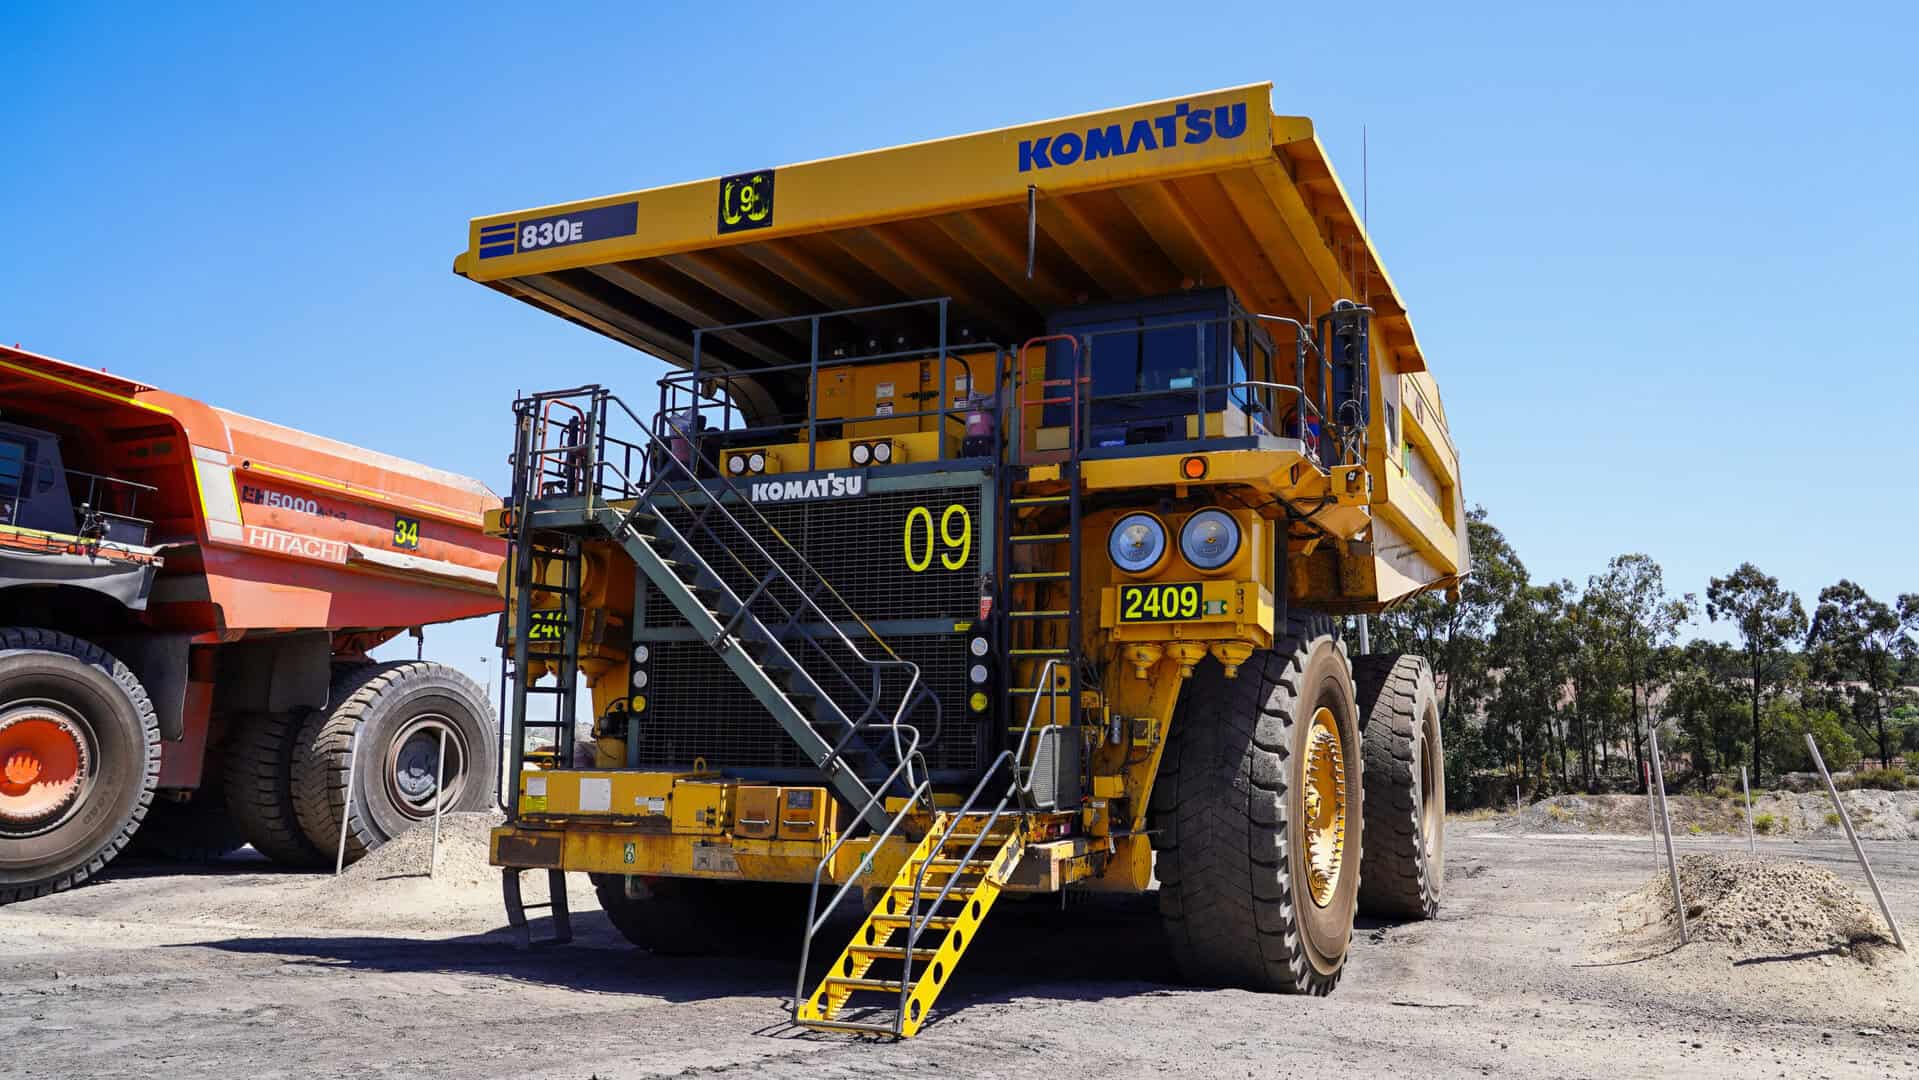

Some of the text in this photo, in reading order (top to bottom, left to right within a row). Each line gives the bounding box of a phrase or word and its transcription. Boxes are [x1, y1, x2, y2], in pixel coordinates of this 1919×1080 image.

[1018, 102, 1247, 172] KOMATSU
[521, 218, 583, 249] 830E
[752, 473, 862, 502] KOMATSU
[248, 527, 345, 561] HITACHI
[395, 519, 418, 546] 34
[904, 504, 972, 572] 09
[1125, 586, 1198, 619] 2409
